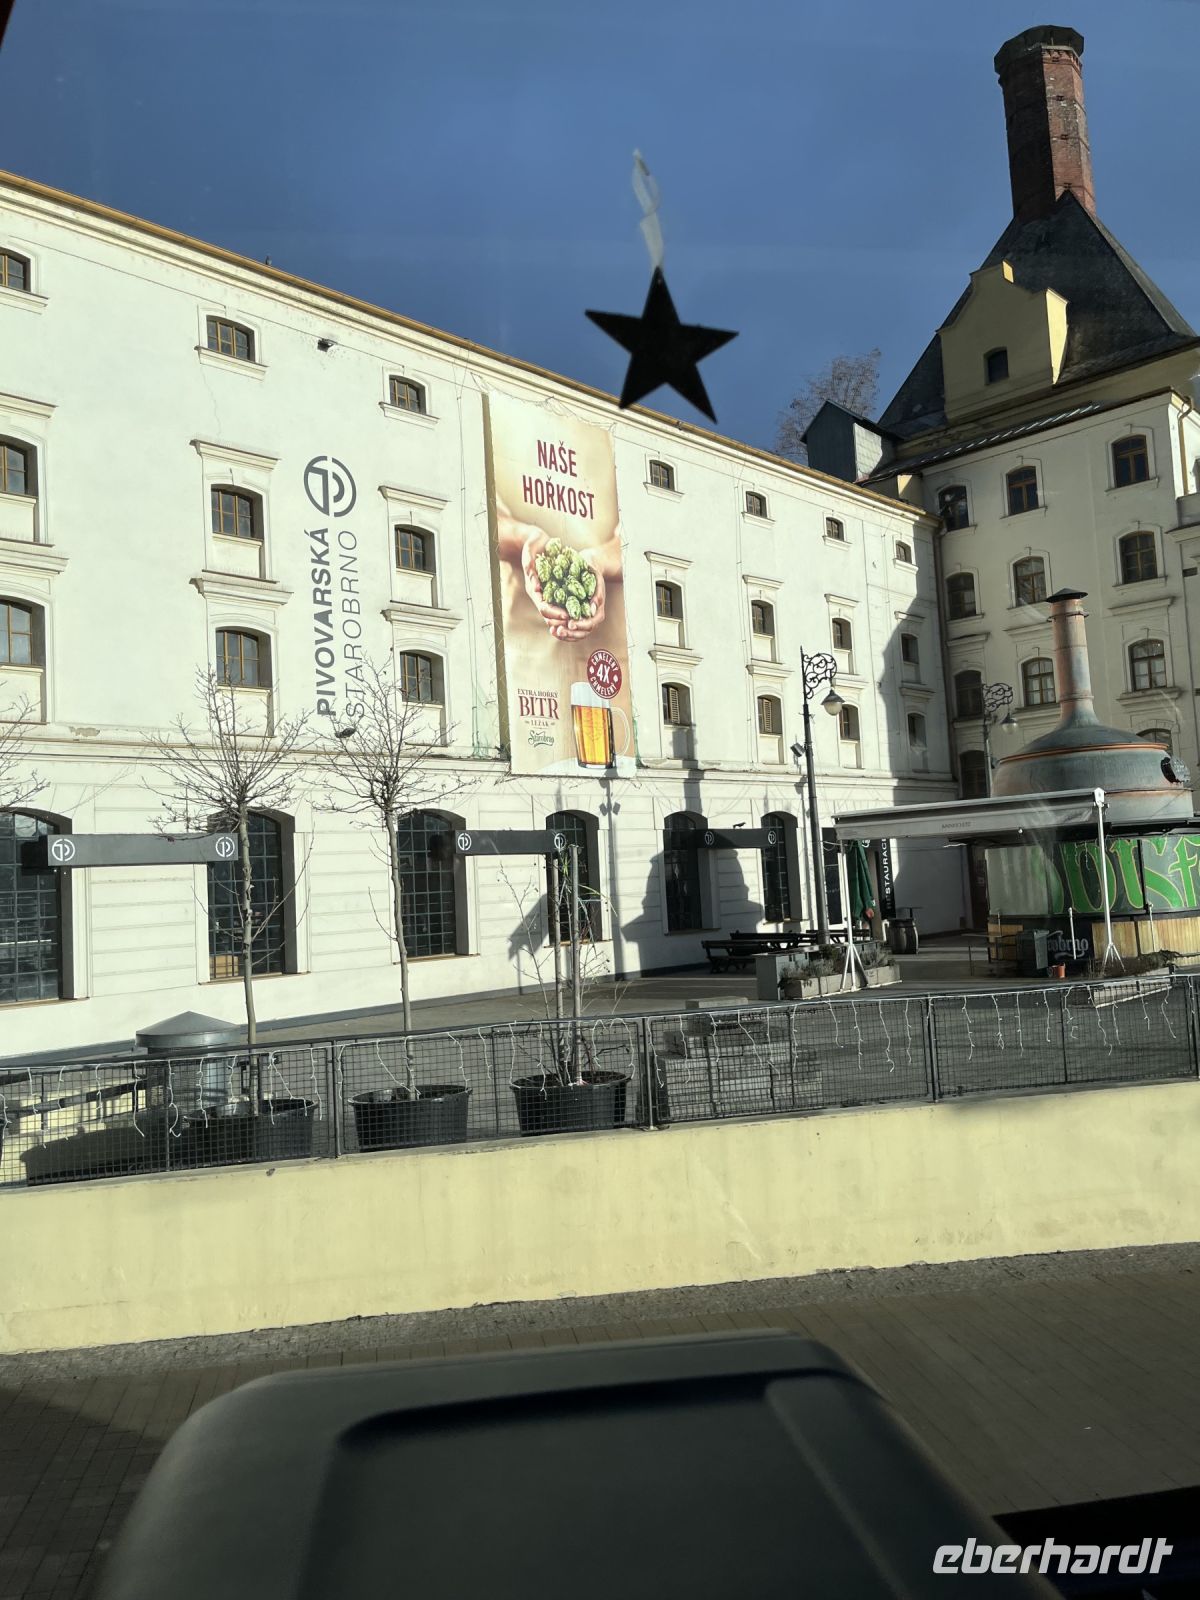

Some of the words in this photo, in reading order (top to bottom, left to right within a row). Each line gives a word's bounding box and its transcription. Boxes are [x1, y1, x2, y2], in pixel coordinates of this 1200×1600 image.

[537, 439, 578, 478] NAŠE
[522, 474, 595, 520] HOŘKOST
[303, 527, 337, 717] PIVOVARSKÁ
[337, 530, 365, 718] STAROBRNO
[517, 688, 537, 697] EXTRA
[596, 663, 610, 684] 4X
[518, 695, 560, 720] BITR
